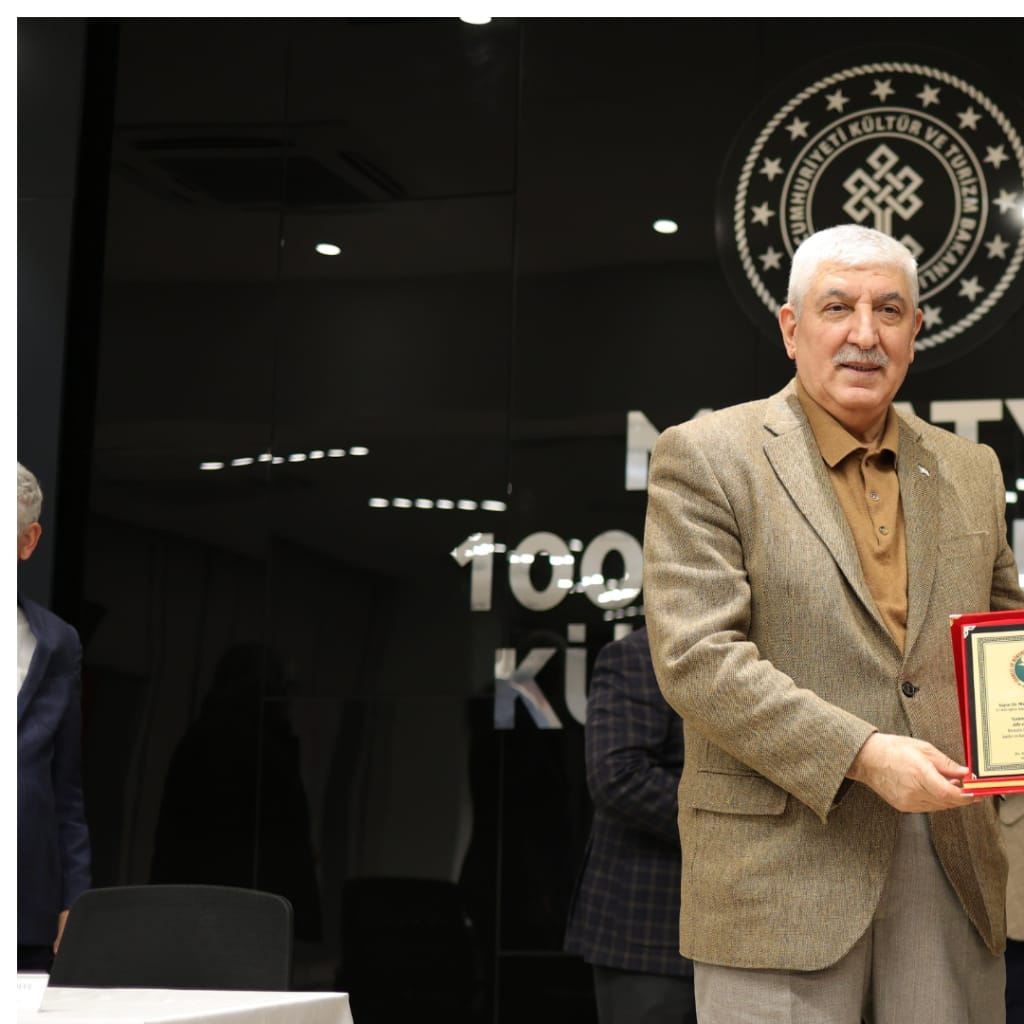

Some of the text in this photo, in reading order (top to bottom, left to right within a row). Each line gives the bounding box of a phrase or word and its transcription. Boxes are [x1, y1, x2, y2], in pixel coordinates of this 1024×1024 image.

[848, 114, 923, 138] KÜLTÜR
[924, 126, 948, 149] VE
[946, 146, 979, 214] TURİZM
[918, 217, 978, 289] BAKANLI
